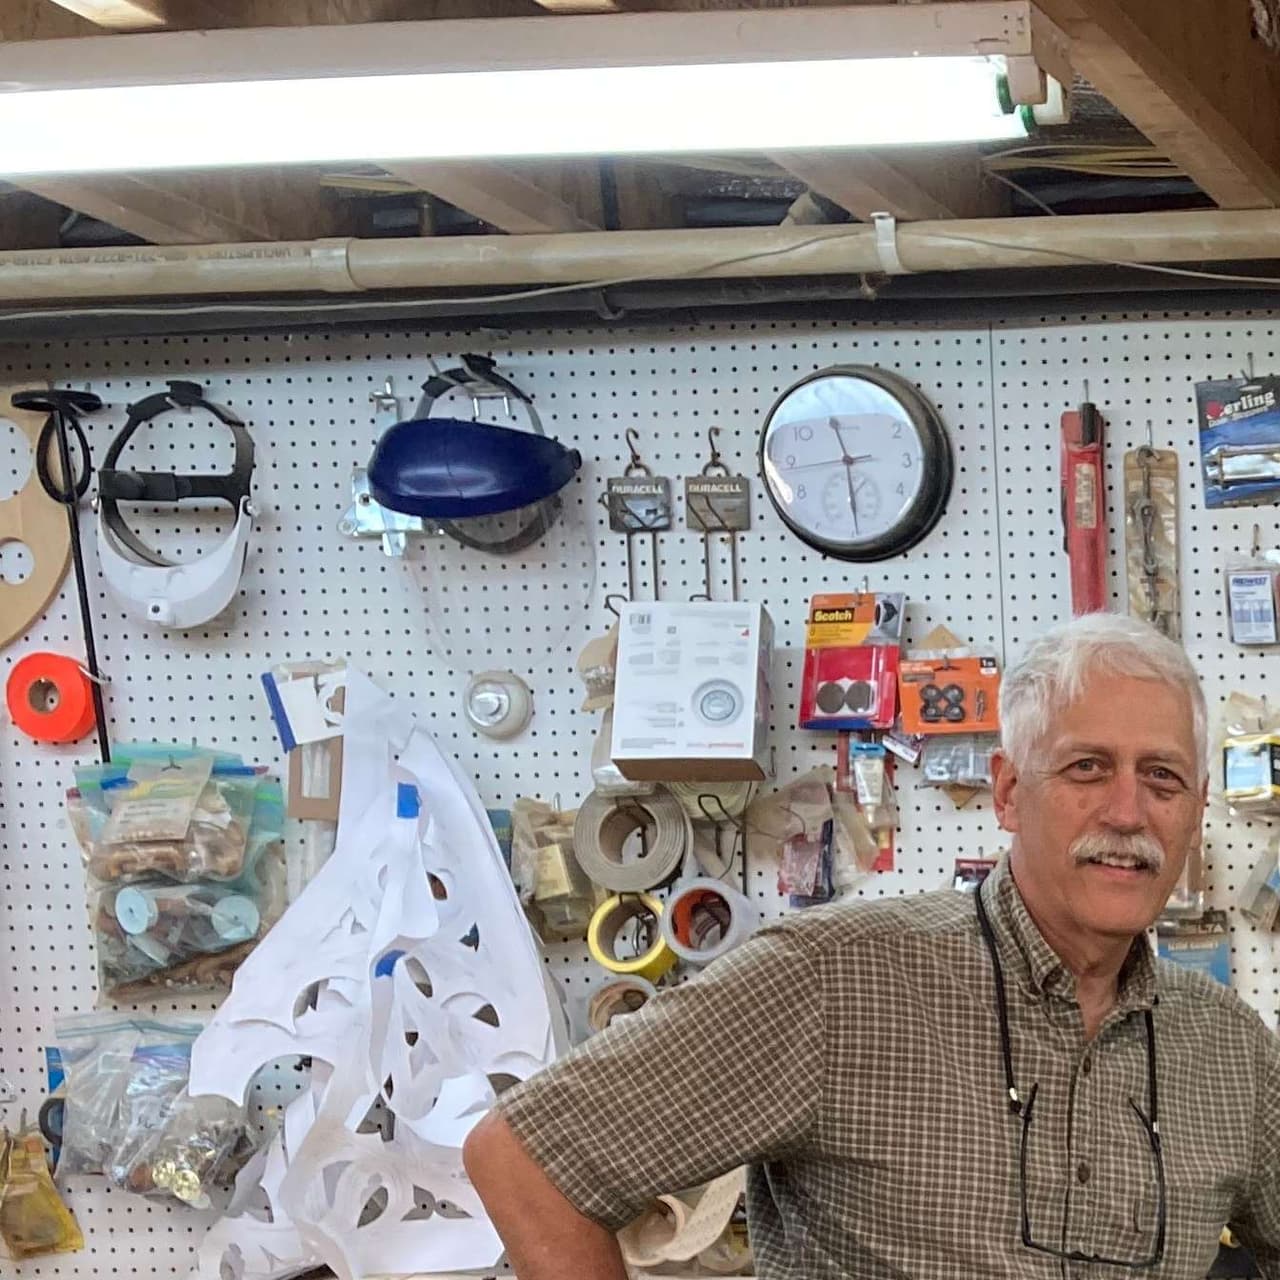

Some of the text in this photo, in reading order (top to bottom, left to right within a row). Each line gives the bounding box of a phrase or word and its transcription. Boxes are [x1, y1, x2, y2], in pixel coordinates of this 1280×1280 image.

[793, 424, 813, 441] 10
[612, 484, 664, 495] DURACELL
[688, 484, 742, 494] DURACELL
[814, 611, 852, 622] Scotch
